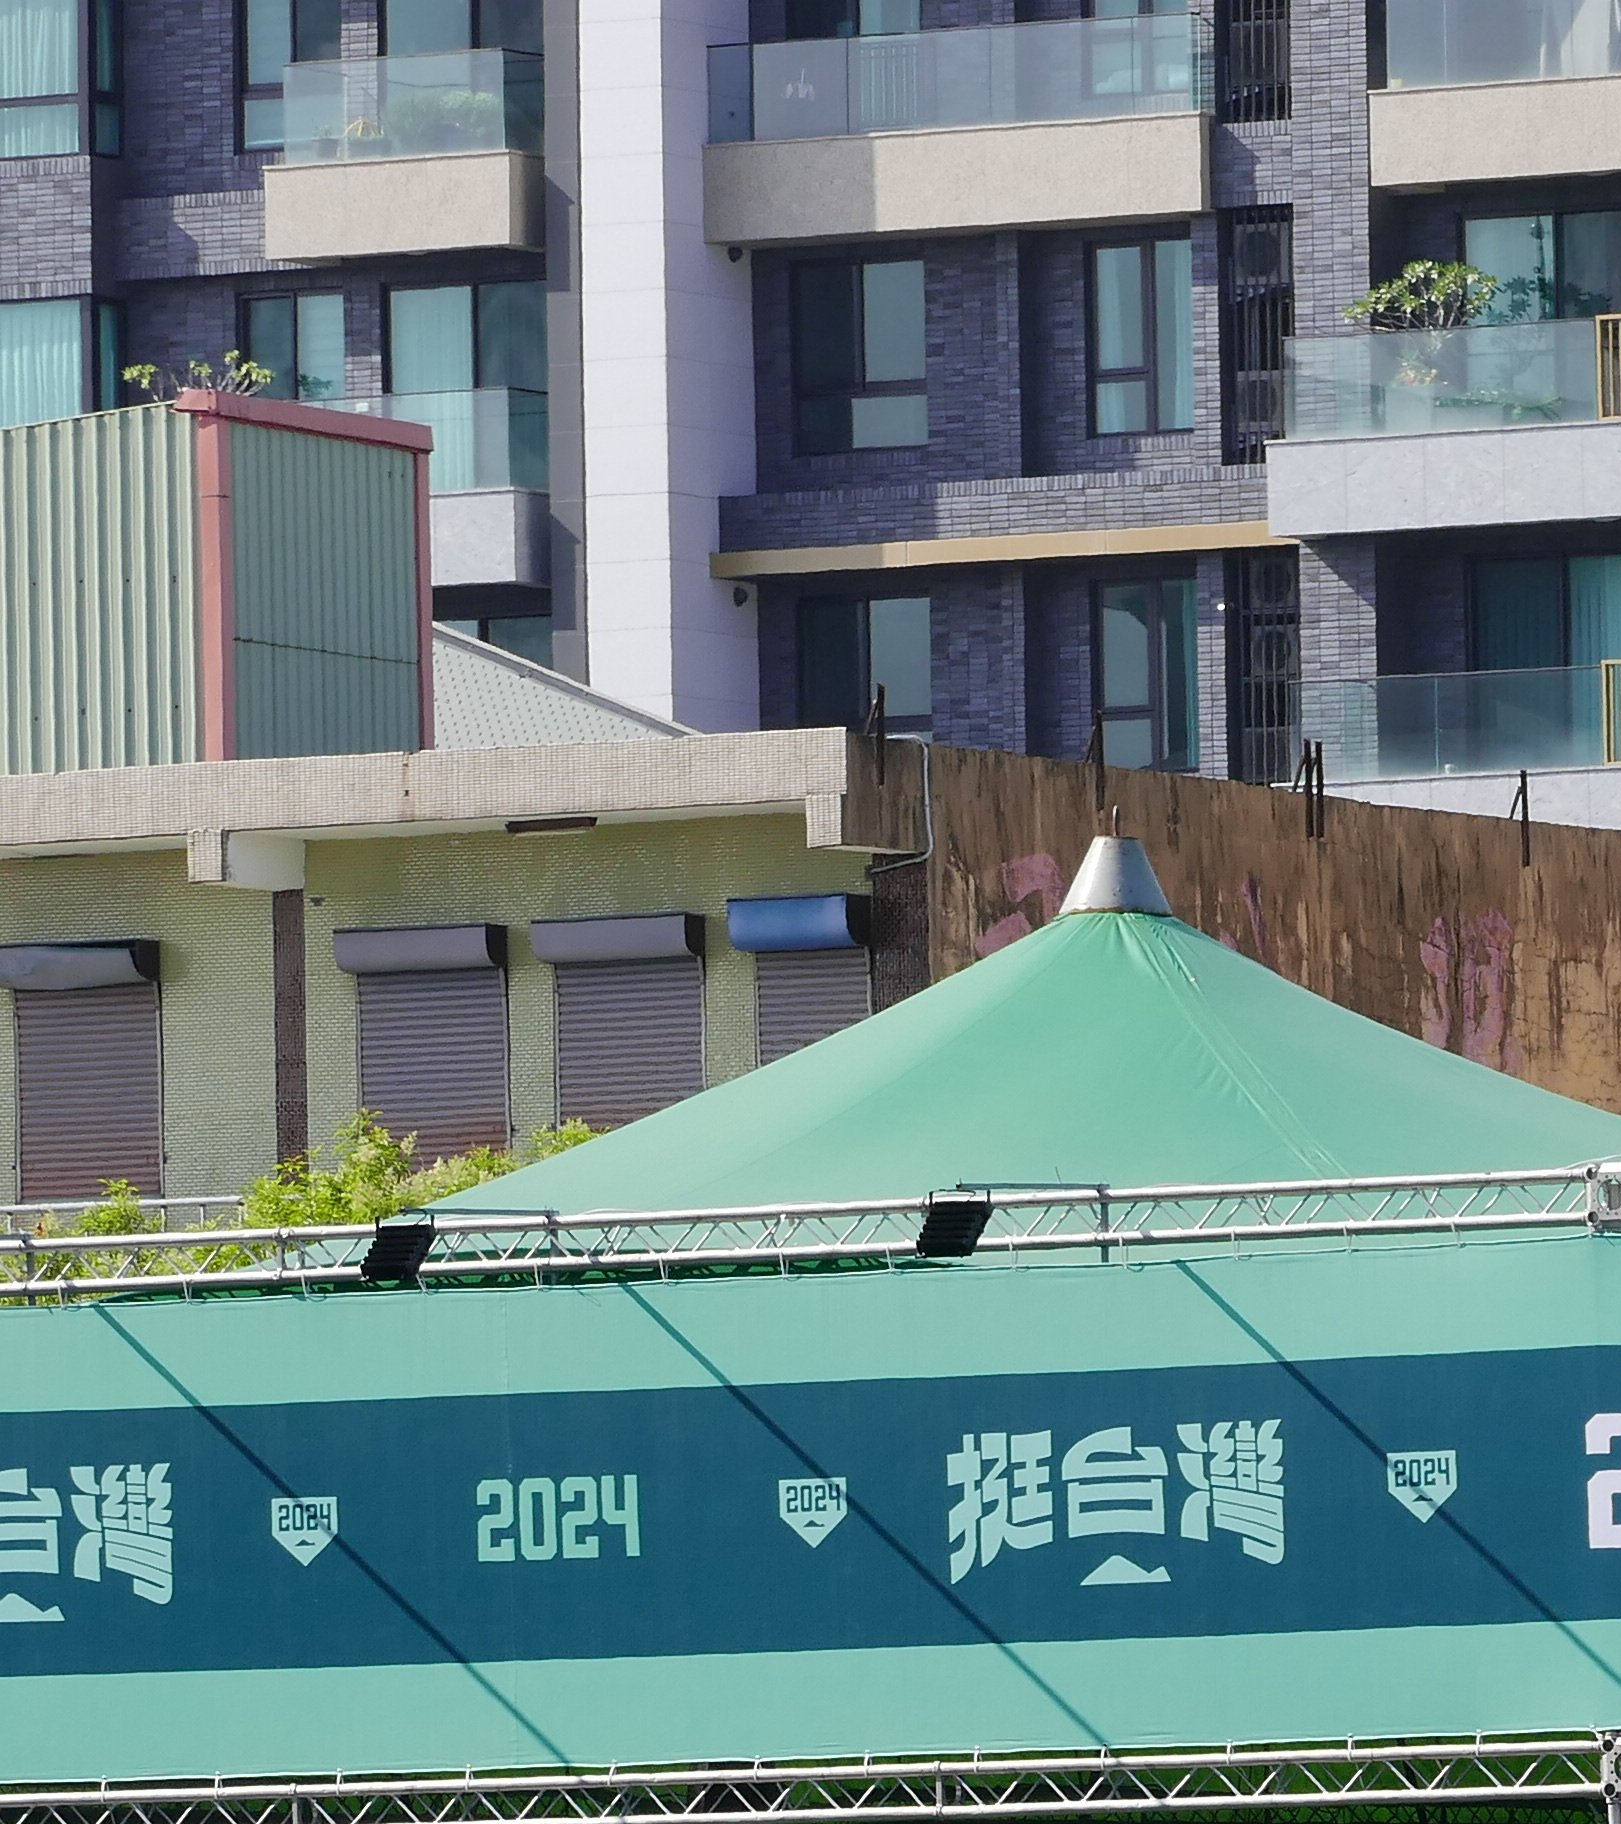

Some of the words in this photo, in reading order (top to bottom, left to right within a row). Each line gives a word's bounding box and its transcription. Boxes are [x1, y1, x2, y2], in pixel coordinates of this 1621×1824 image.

[1393, 1457, 1450, 1487] 2024
[786, 1482, 843, 1513] 2024
[946, 1417, 1285, 1584] 挺台灣
[278, 1502, 331, 1532] 2024
[477, 1474, 642, 1563] 2024
